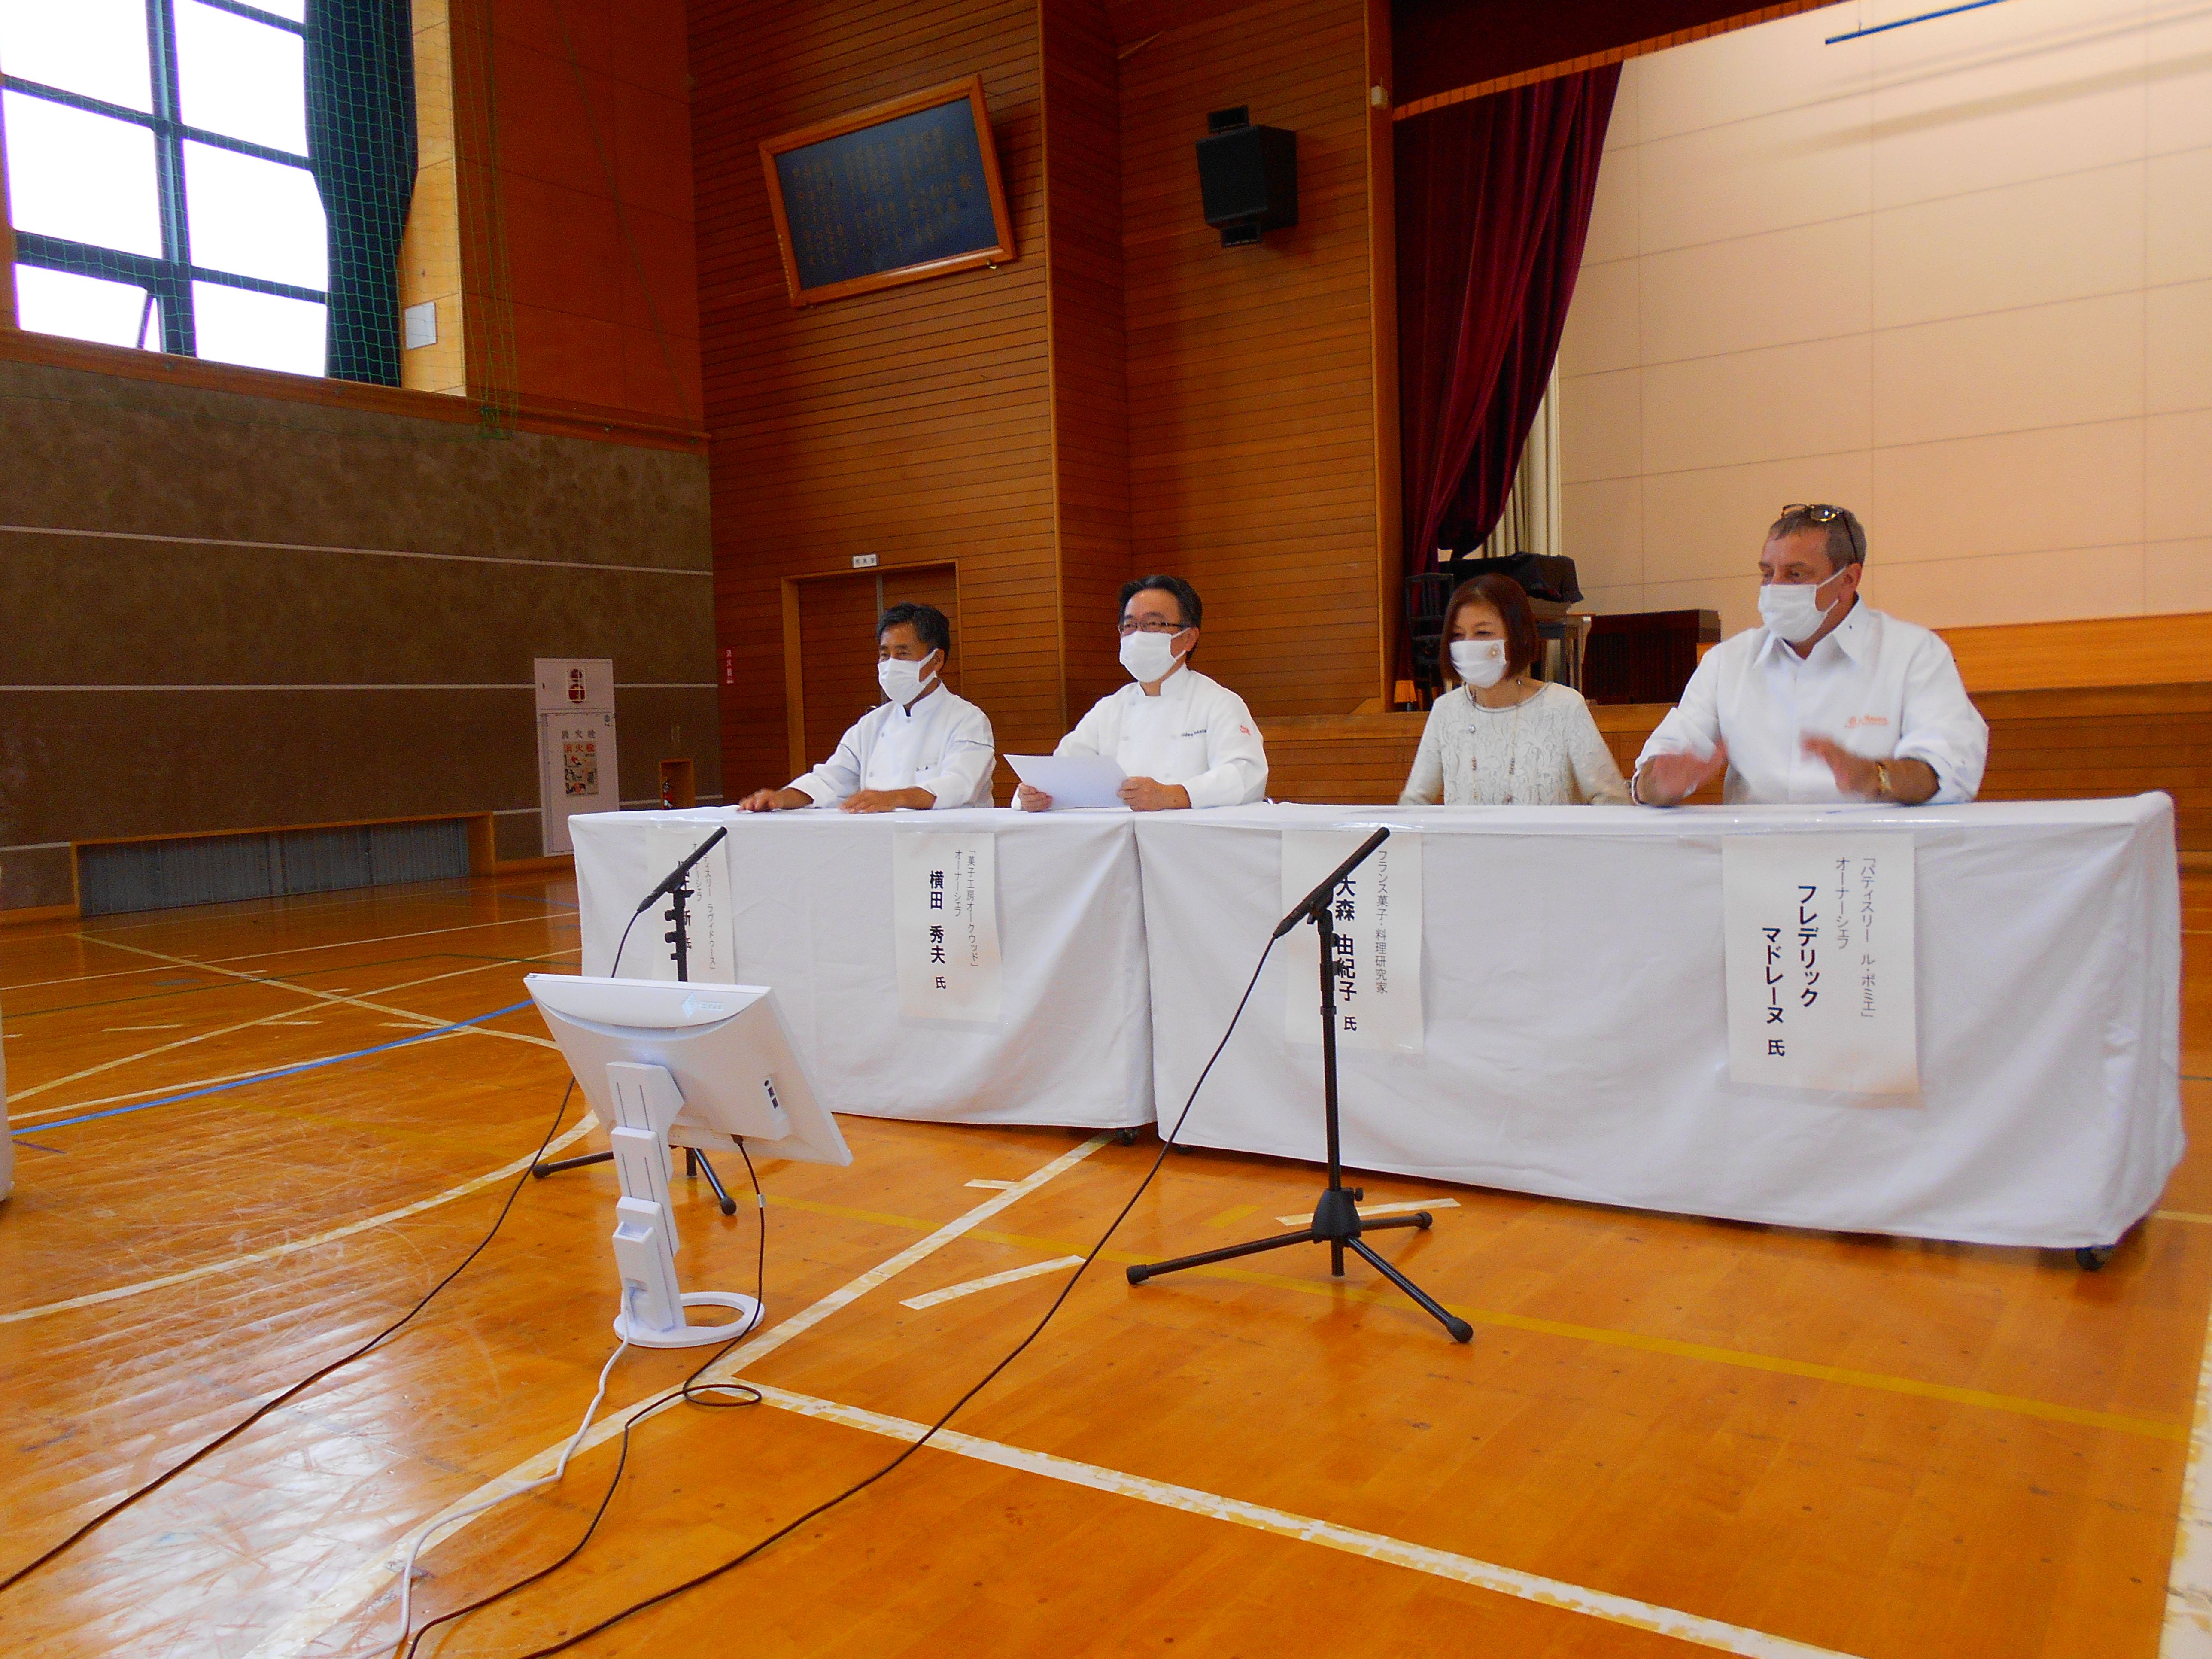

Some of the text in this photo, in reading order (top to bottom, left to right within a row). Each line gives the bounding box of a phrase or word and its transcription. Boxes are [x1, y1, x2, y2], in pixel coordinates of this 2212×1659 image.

[564, 744, 595, 752] 消火栓
[930, 870, 946, 989] 横田 秀夫 氏
[954, 850, 963, 917] オーナーシェフ
[1375, 851, 1388, 994] フランス菓子・料理研究家
[1836, 857, 1850, 949] オーナーシェフ
[1335, 875, 1357, 1031] 大森 由紀子 氏
[1762, 928, 1785, 1056] マドレーヌ 氏
[1798, 885, 1820, 1007] フレデリック
